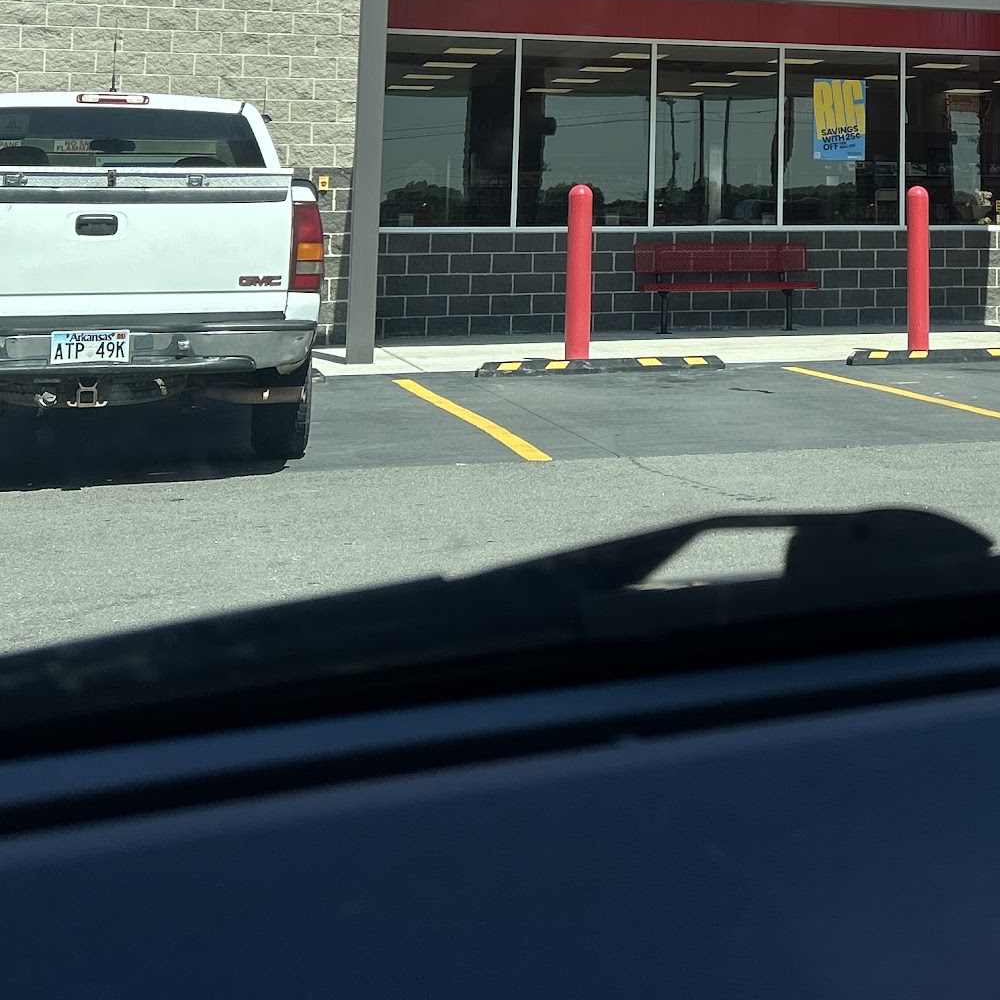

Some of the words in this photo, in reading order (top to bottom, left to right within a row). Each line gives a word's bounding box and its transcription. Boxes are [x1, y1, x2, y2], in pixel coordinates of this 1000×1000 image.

[821, 125, 859, 136] SAVINGS
[822, 134, 845, 143] WITH
[823, 142, 839, 151] OFF
[239, 275, 282, 286] GMC
[69, 333, 112, 342] Arkansas
[54, 342, 85, 360] ATP
[96, 341, 125, 358] 49K
